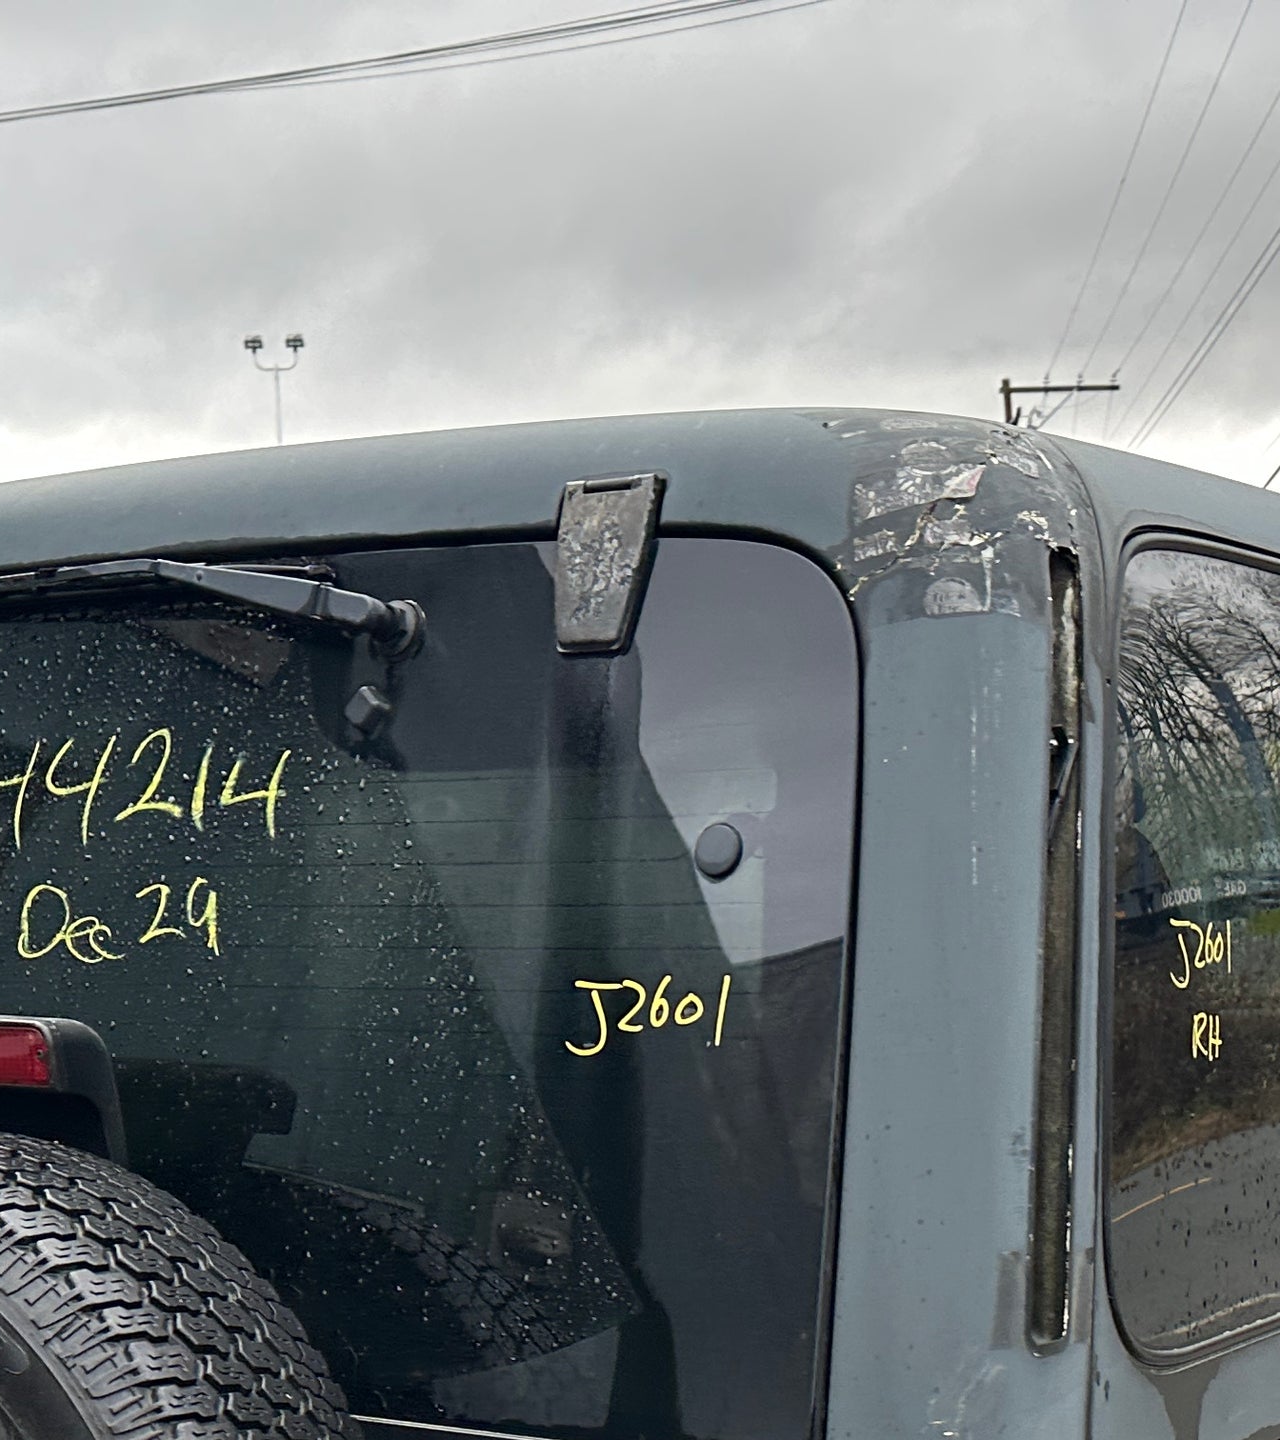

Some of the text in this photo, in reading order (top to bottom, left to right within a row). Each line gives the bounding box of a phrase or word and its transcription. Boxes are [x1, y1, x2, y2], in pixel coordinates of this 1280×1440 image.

[18, 876, 220, 963] Dec 29
[1169, 917, 1232, 989] J2601
[565, 974, 731, 1057] J2601
[1192, 1011, 1222, 1062] RH
